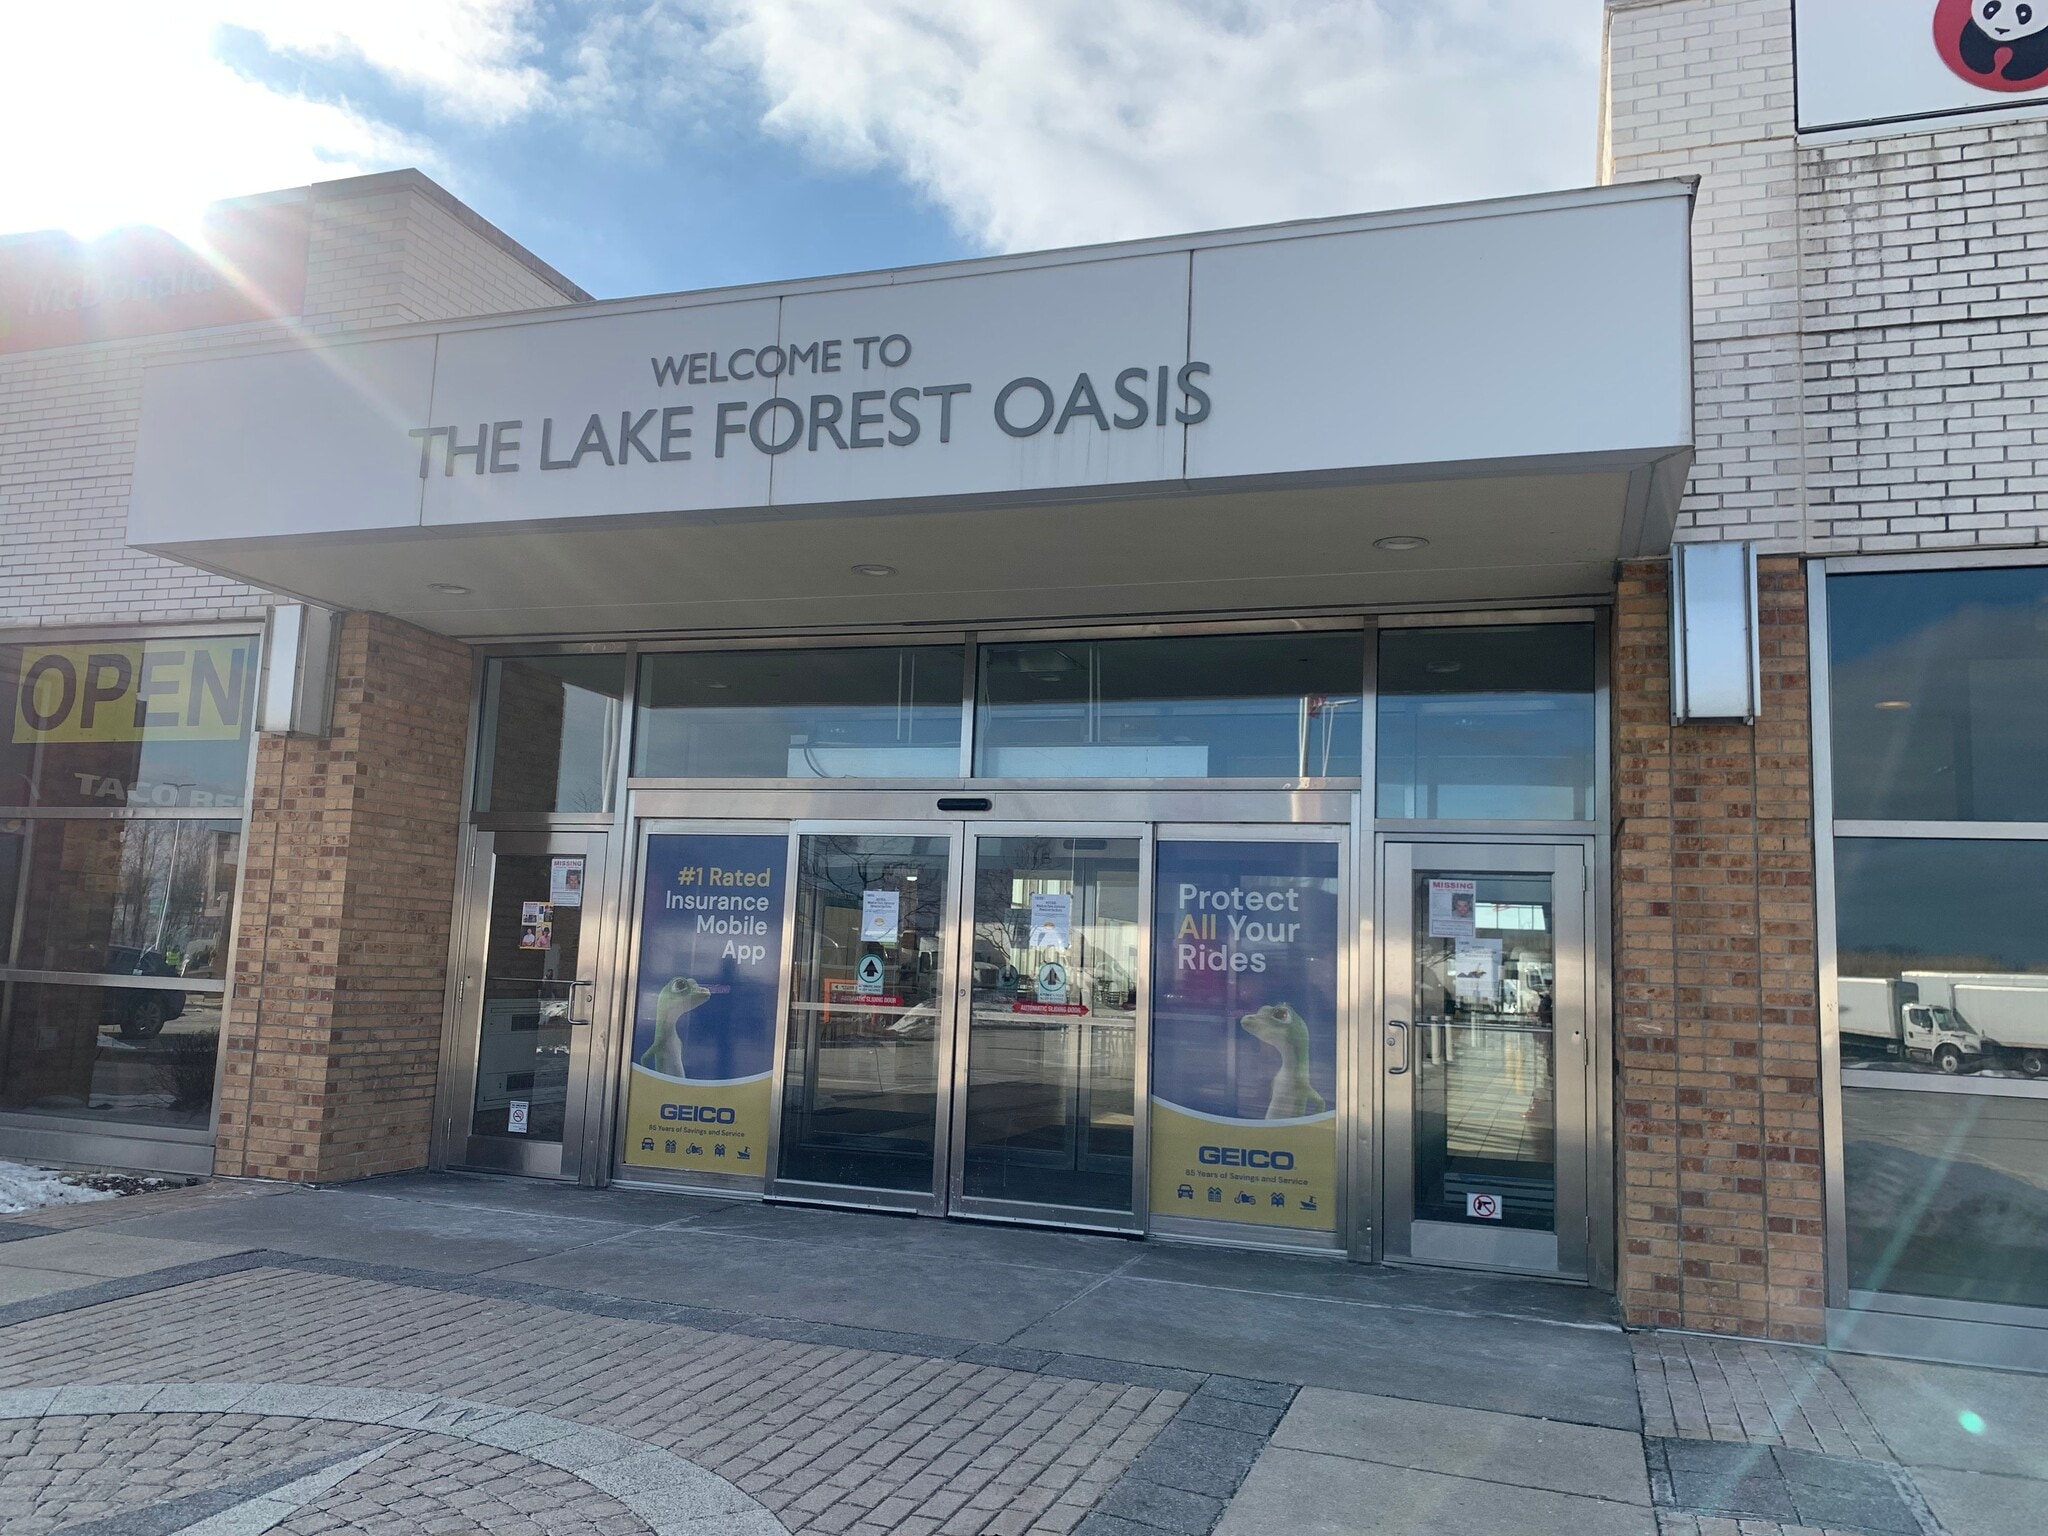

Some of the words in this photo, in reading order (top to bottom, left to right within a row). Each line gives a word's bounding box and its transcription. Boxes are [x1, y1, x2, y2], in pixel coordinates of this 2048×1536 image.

[28, 268, 218, 316] McDonald
[651, 338, 841, 387] WELCOME
[854, 333, 912, 370] TO
[408, 419, 523, 478] THE
[540, 408, 692, 470] LAKE
[714, 382, 971, 457] FOREST
[994, 360, 1213, 438] OASIS
[21, 648, 245, 731] OPEN
[74, 773, 178, 806] TACO
[678, 867, 703, 886] #1
[709, 867, 771, 887] Rated
[1432, 881, 1474, 890] MISSING
[665, 890, 769, 911] Insurance
[1179, 883, 1299, 912] Protect
[696, 914, 768, 936] Mobile
[1178, 914, 1217, 940] All
[1227, 915, 1300, 942] Your
[721, 940, 766, 965] App
[1178, 944, 1266, 973] Rides
[660, 1103, 735, 1124] GEICO
[683, 1127, 707, 1136] Savings
[721, 1130, 745, 1138] Service
[1199, 1146, 1294, 1171] GEICO
[1185, 1169, 1196, 1177] 85
[1197, 1170, 1218, 1179] Years
[1230, 1173, 1259, 1183] Savings
[1278, 1176, 1308, 1186] Service
